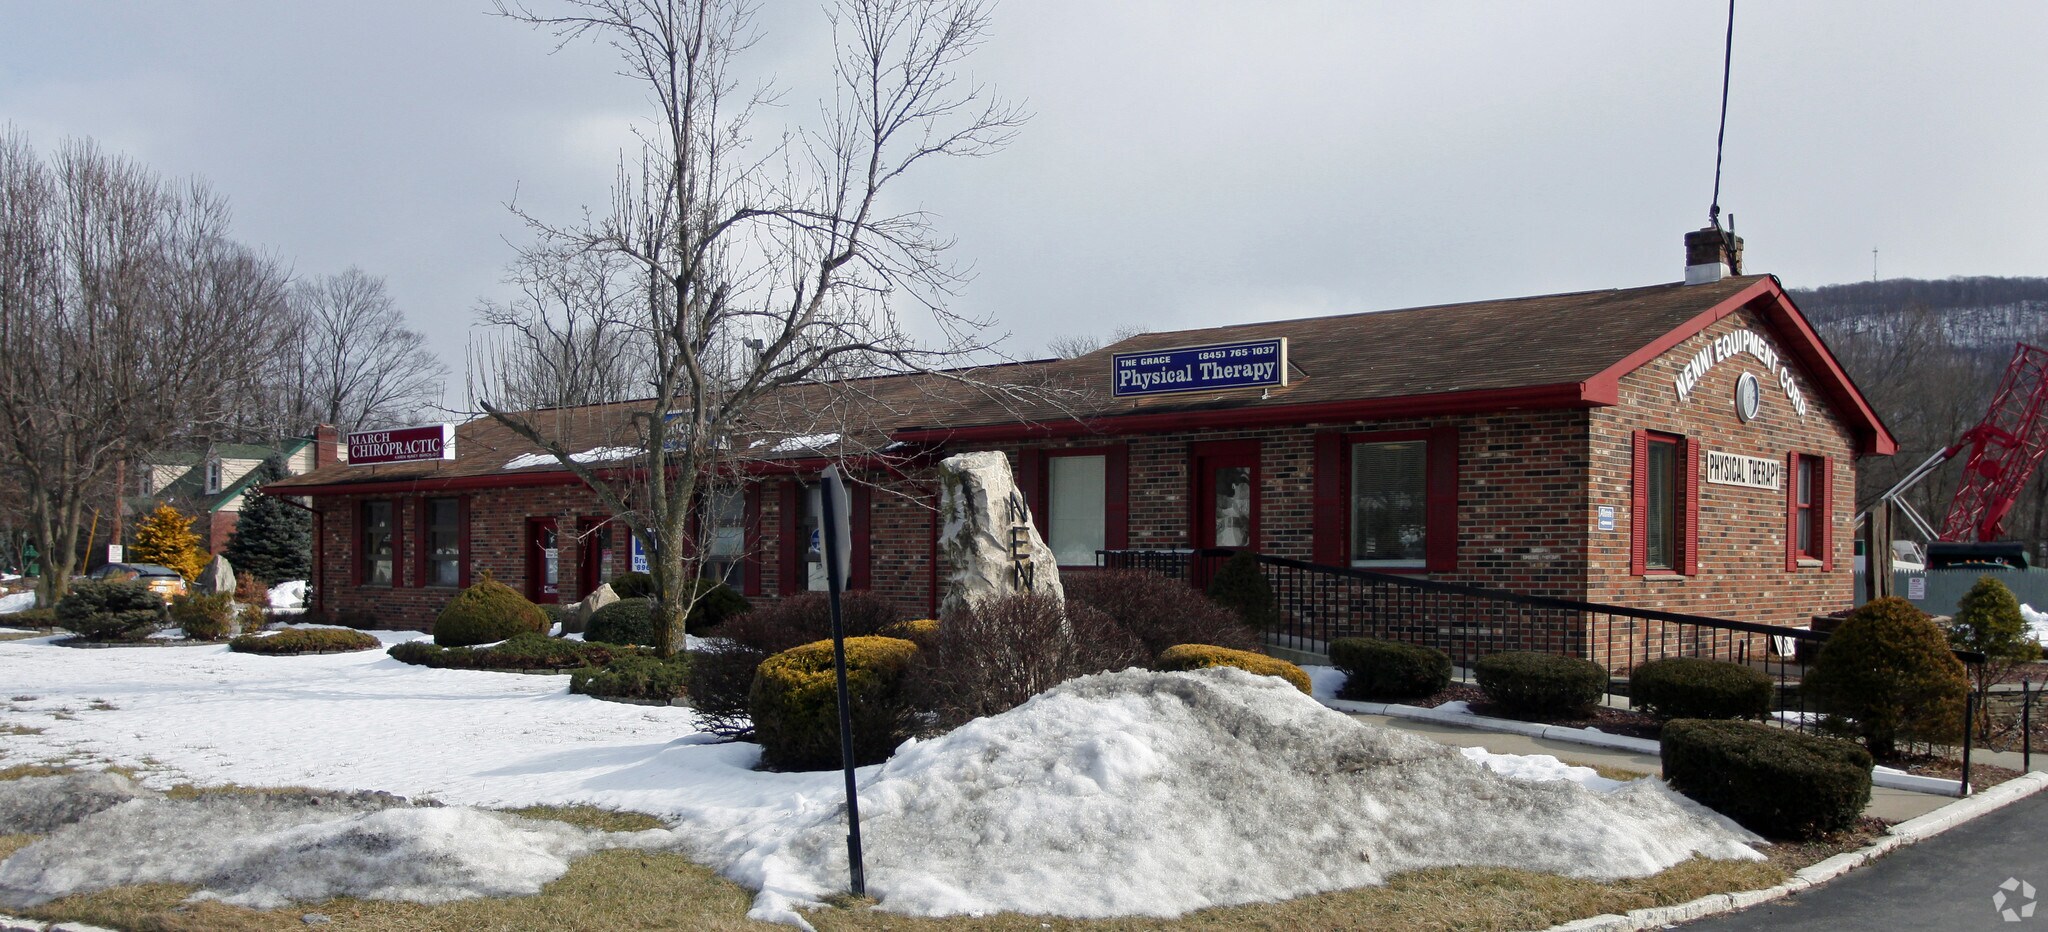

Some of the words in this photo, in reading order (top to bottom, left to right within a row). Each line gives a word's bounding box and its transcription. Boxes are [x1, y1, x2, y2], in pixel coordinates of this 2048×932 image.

[1120, 359, 1137, 367] THE
[1140, 356, 1171, 366] GRACE
[1675, 344, 1713, 402] NENNI
[1714, 329, 1779, 375] EQUIPMENT
[1119, 364, 1193, 390] Physical
[1199, 361, 1276, 381] Therapy
[350, 432, 390, 445] MARCH
[351, 438, 440, 458] CHIROPRACTIC
[1709, 453, 1746, 483] PHYSICAL
[1748, 459, 1779, 487] THERAPY
